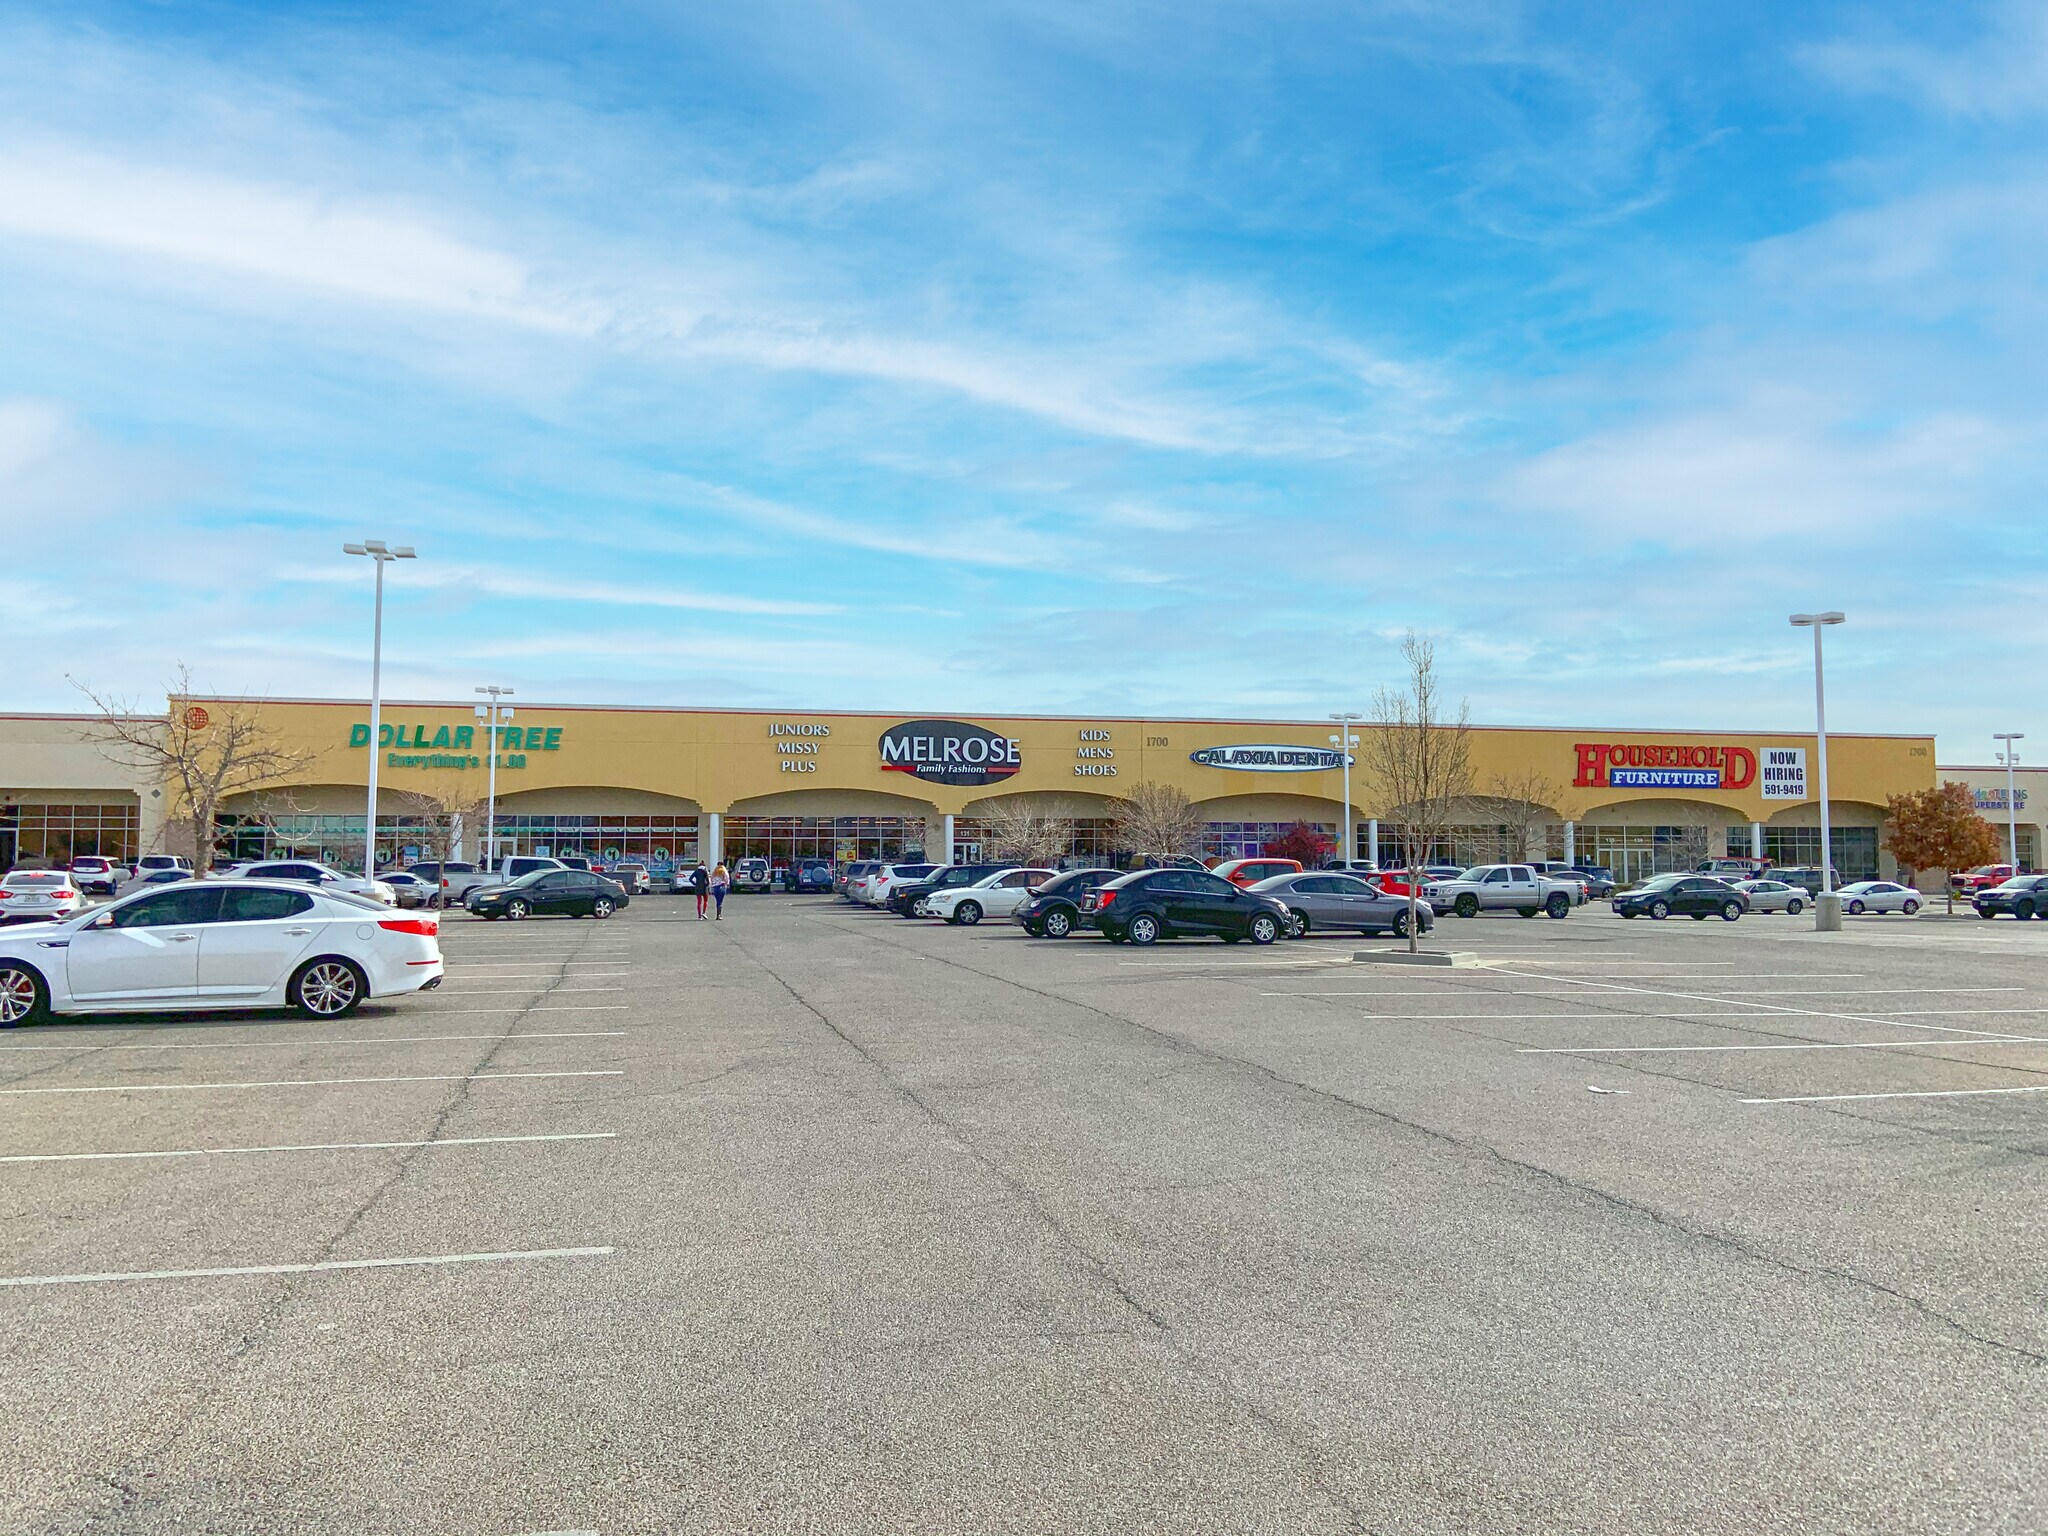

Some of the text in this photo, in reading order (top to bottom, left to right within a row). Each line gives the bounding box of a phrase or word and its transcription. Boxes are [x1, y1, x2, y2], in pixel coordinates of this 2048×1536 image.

[349, 723, 564, 750] DOLLAR TREE
[769, 723, 830, 738] JUNIORS
[1080, 729, 1111, 742] KIDS
[777, 742, 821, 754] MISSY
[1146, 736, 1169, 748] 1700
[881, 735, 1021, 763] MELROSE
[1077, 747, 1114, 759] MENS
[387, 752, 480, 770] Everything's
[1770, 751, 1797, 765] NOW
[781, 760, 816, 773] PLUS
[916, 763, 987, 775] Family Fashions
[1074, 764, 1118, 777] SHOES
[1573, 743, 1757, 790] HOUSEHOLD
[1613, 771, 1718, 786] FURNITURE
[1764, 767, 1803, 781] HIRING
[1764, 784, 1804, 796] 591-9419
[1972, 801, 2026, 810] UPERSTRE
